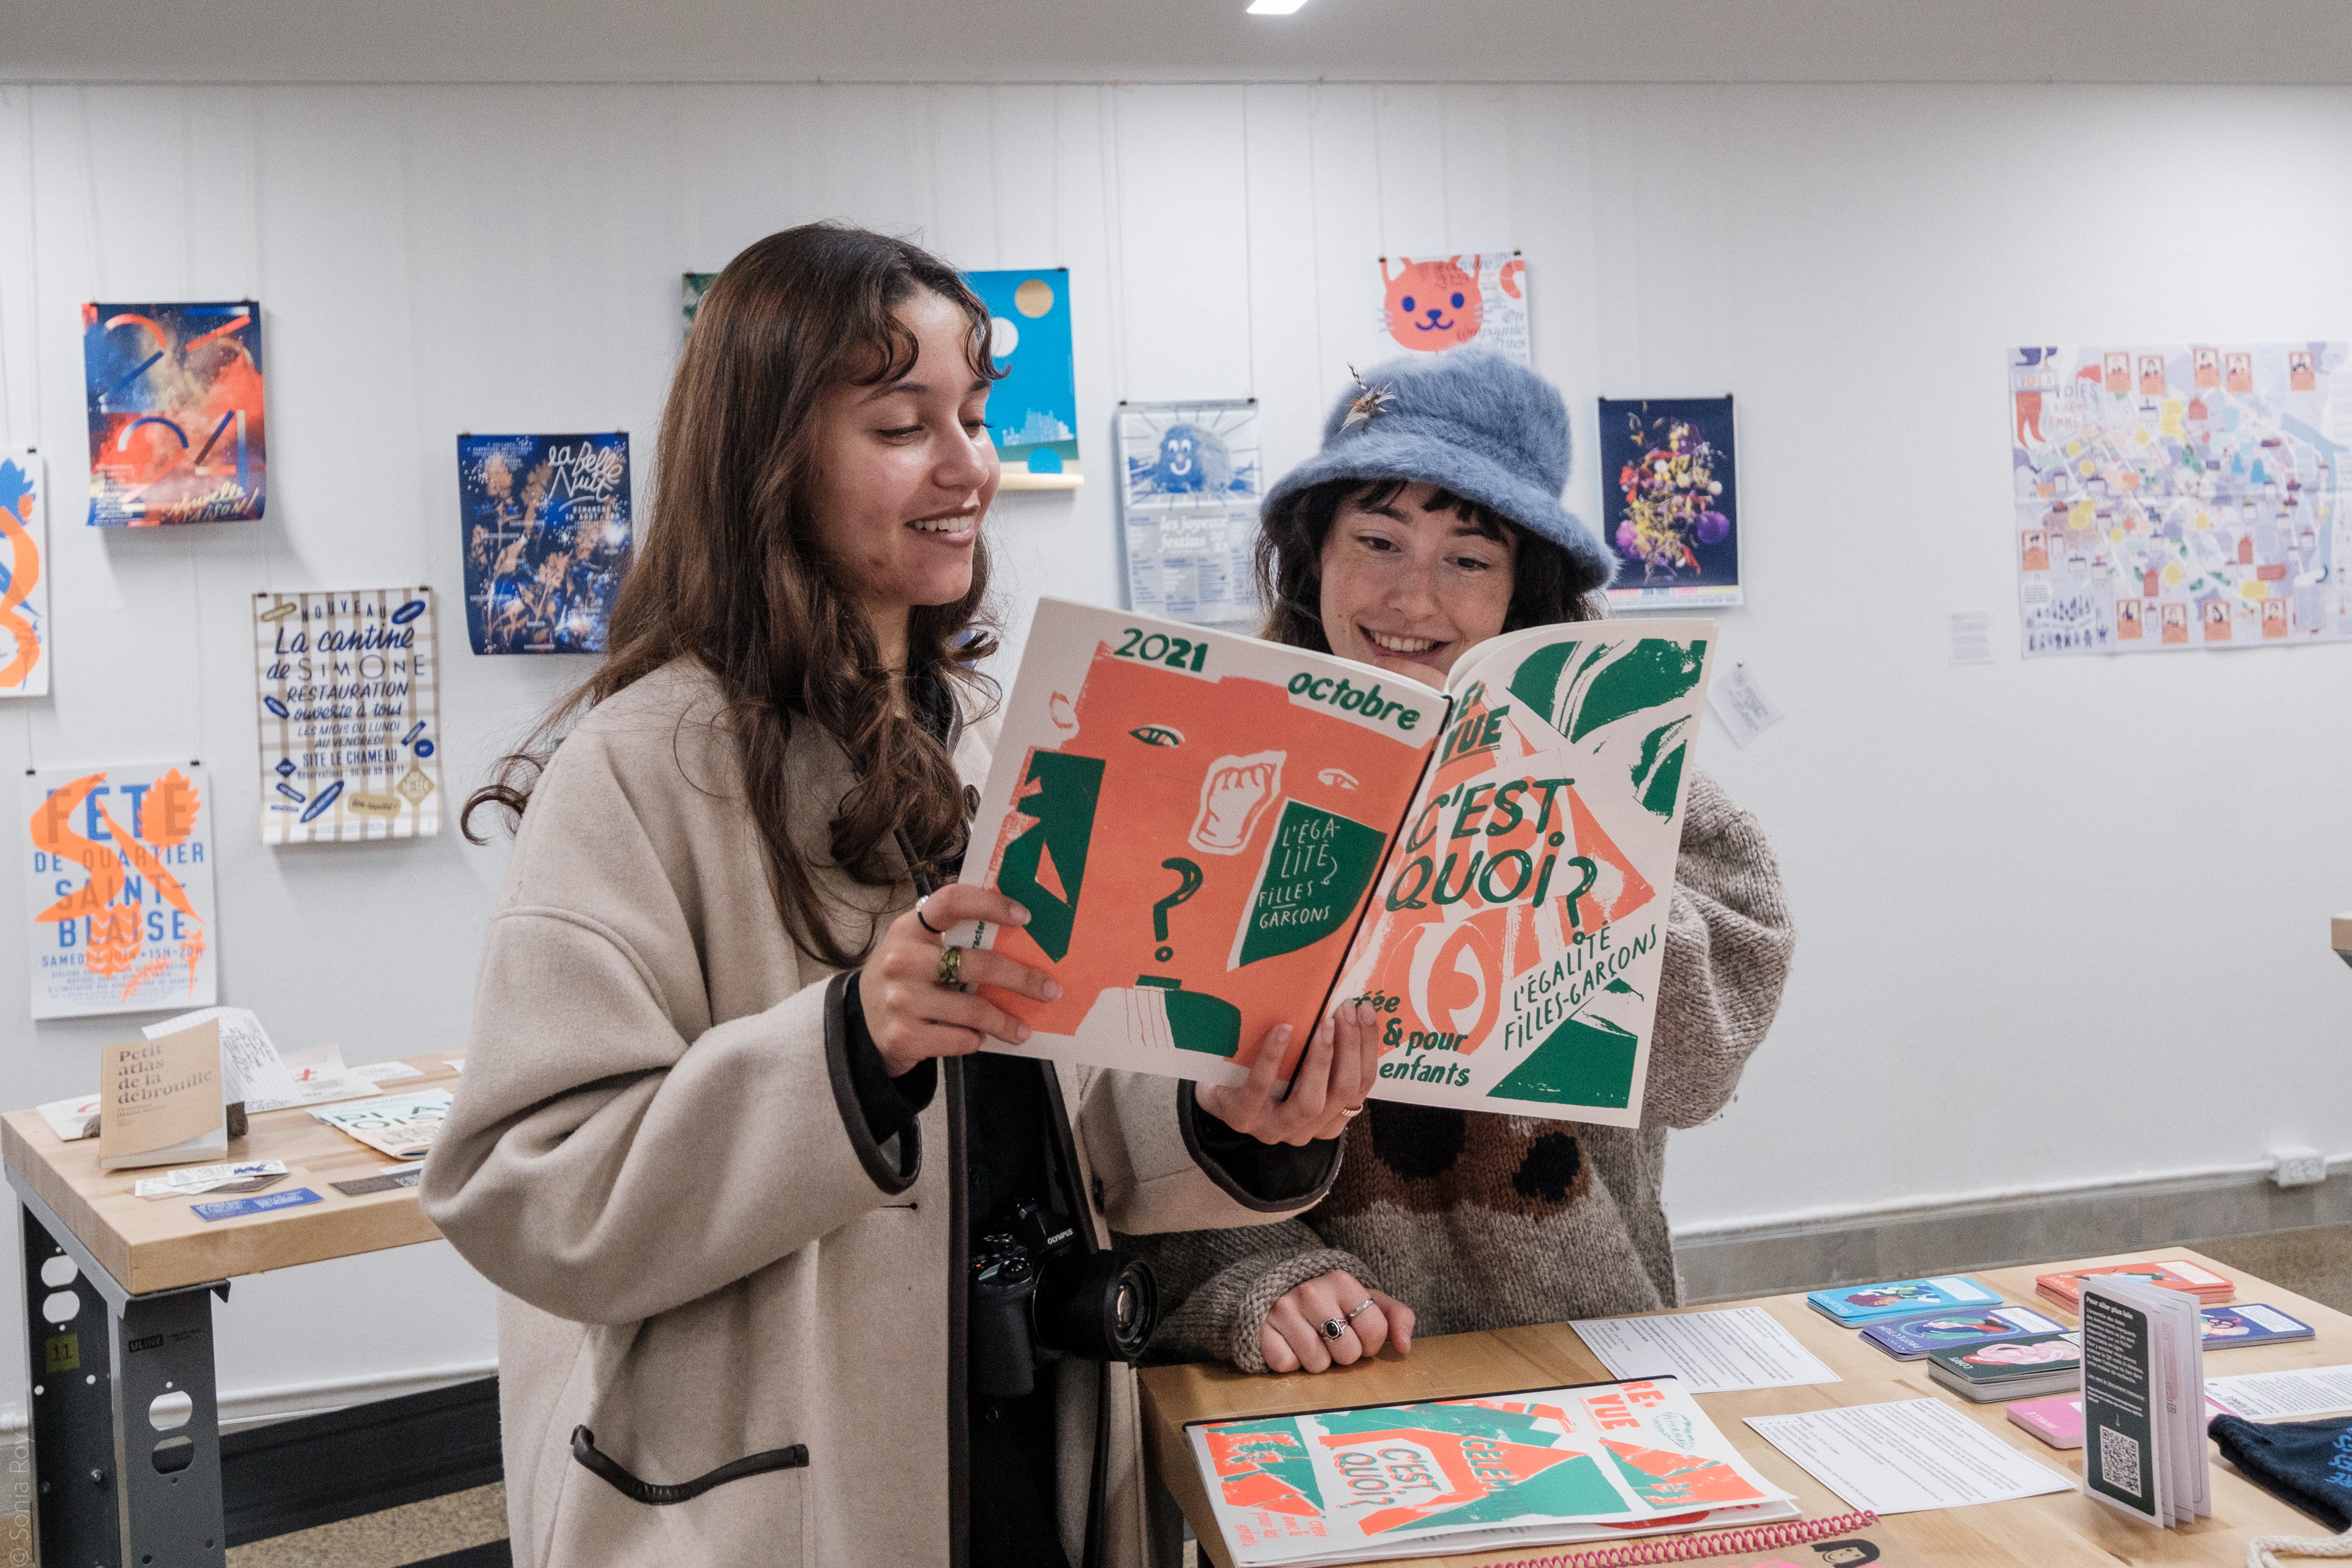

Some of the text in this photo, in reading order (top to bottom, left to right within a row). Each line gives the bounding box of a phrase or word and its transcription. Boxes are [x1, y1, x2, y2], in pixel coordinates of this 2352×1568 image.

[301, 600, 386, 622] NOUVEAU
[274, 623, 414, 654] La cantine
[1114, 627, 1209, 672] 2021
[267, 661, 290, 679] de
[287, 682, 408, 703] RESTAURATION
[1287, 672, 1421, 731] octobre
[298, 724, 317, 736] LES
[368, 722, 401, 733] LUNDI
[303, 751, 325, 767] SITE
[330, 750, 342, 766] LE
[346, 747, 398, 764] CHAMEAU
[47, 774, 190, 844] FÊTE
[1405, 777, 1575, 854] C'EST
[35, 842, 204, 873] DE QUARTIER
[59, 910, 187, 948] BLAISE
[119, 1044, 163, 1061] Petit
[1383, 1018, 1468, 1056] & pour
[118, 1059, 164, 1076] atlas
[118, 1074, 161, 1090] de la
[1379, 1055, 1470, 1087] enfants
[118, 1071, 212, 1104] débrouille
[1047, 1228, 1073, 1245] OLYMPUS
[1948, 1355, 1973, 1370] CORPS
[1587, 1393, 1642, 1430] VUE
[2025, 1411, 2059, 1430] FAMILLE
[1376, 1447, 1444, 1493] C'EST
